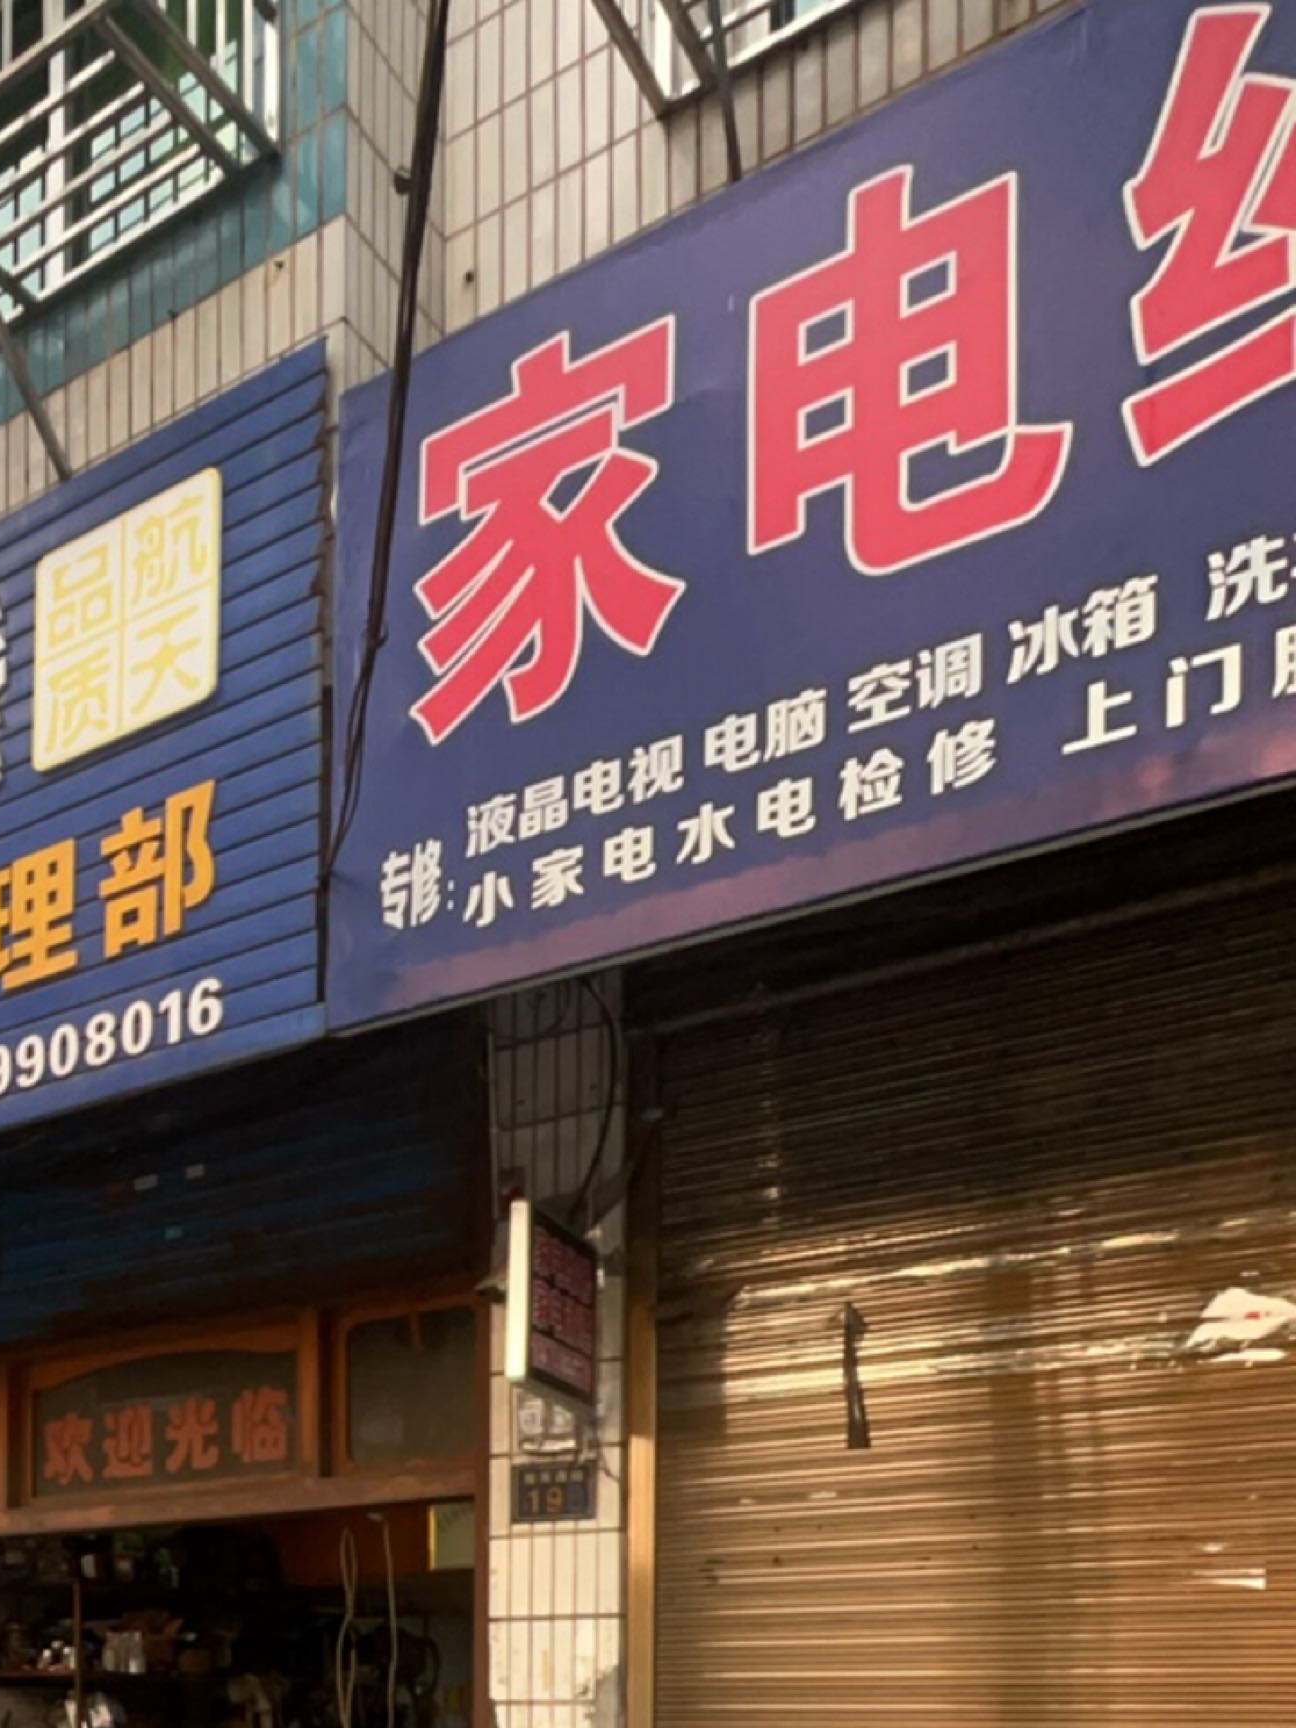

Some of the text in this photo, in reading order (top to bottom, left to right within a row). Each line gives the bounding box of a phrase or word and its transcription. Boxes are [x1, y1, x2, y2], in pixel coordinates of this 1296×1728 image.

[465, 533, 1296, 859] 液晶电视 电脑 空调 冰箱 洗
[462, 718, 996, 928] 小家电水电检修
[43, 1385, 289, 1485] 欢迎光临
